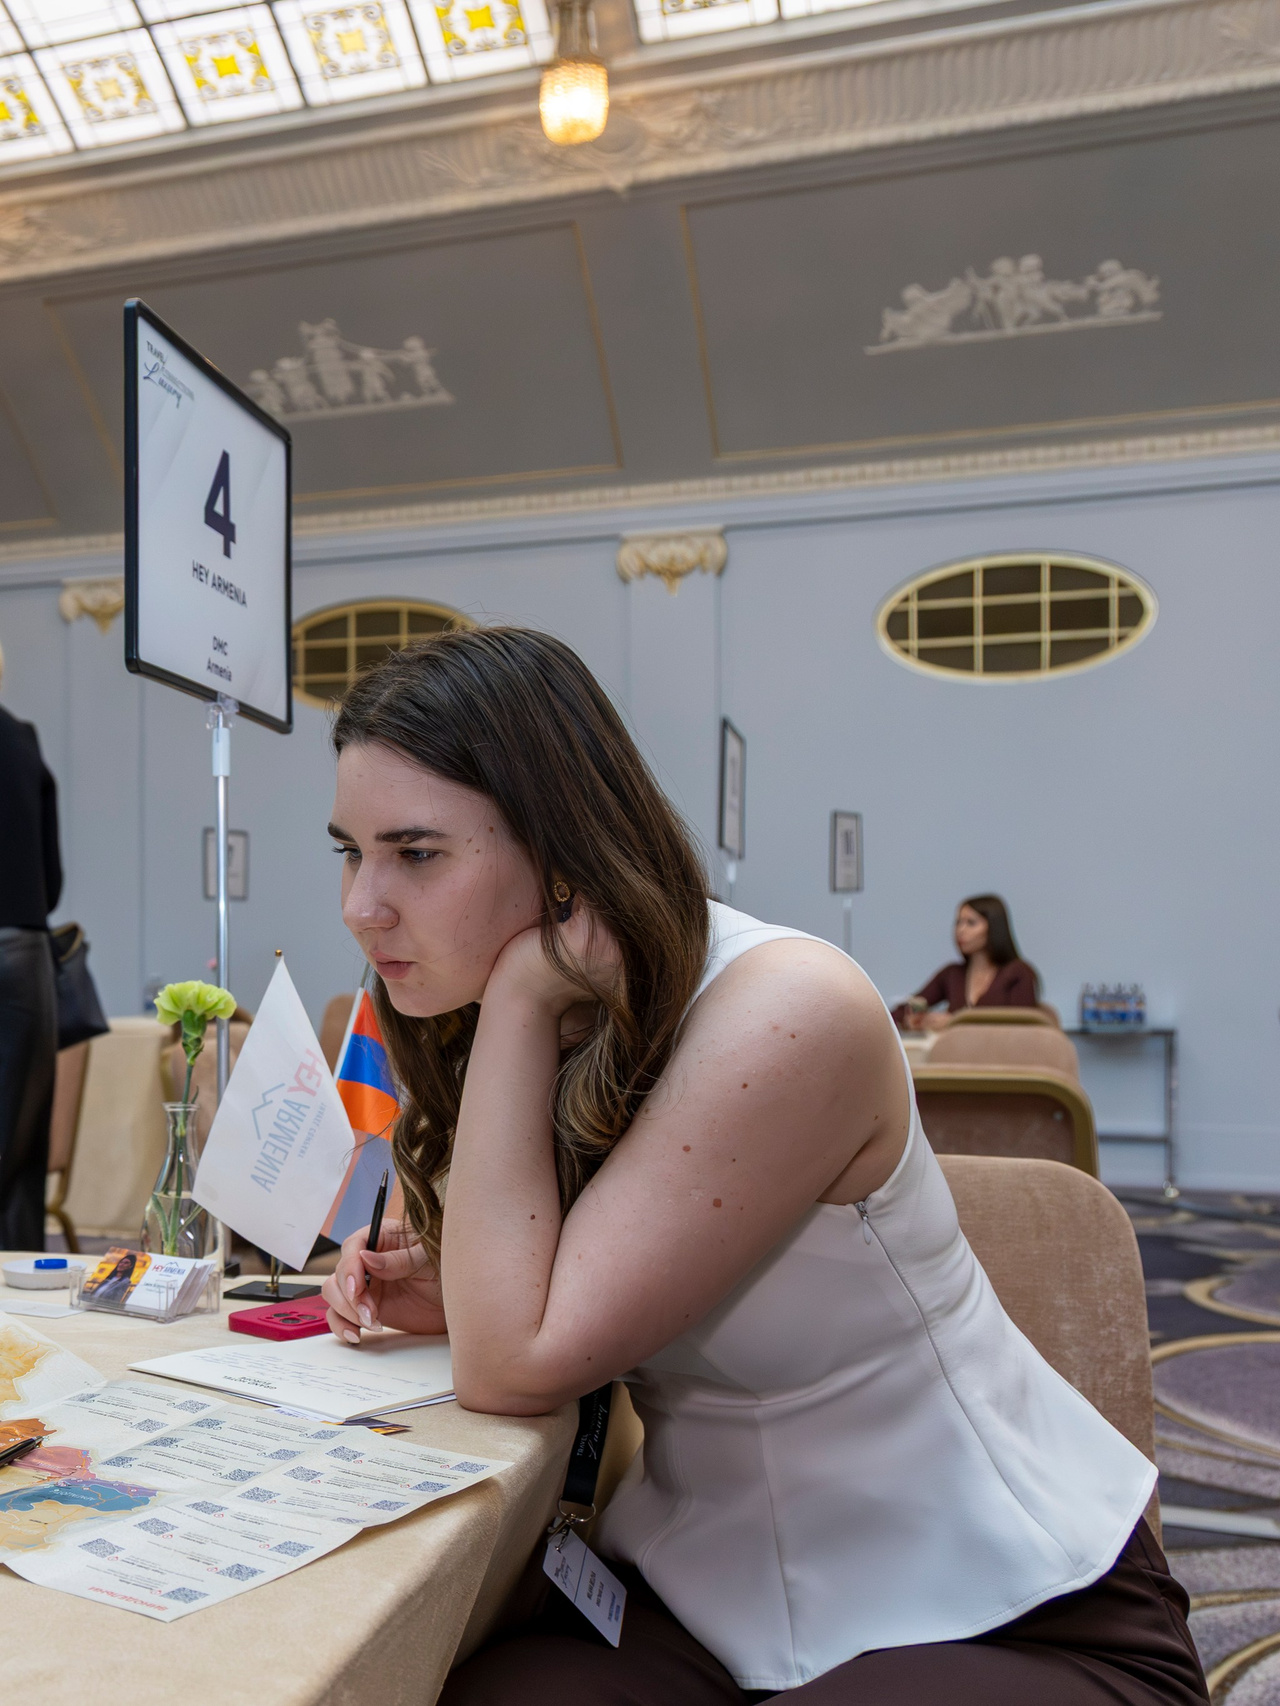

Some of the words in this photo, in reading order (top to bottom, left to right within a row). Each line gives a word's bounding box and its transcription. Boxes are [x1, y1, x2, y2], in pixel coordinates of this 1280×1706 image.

[204, 449, 236, 559] 4
[192, 560, 209, 585] HEY
[211, 572, 247, 608] ARMENIA
[213, 636, 228, 656] DMC
[206, 657, 232, 682] Armenia
[577, 1434, 588, 1456] TRAVEL
[588, 1404, 608, 1460] Luxury
